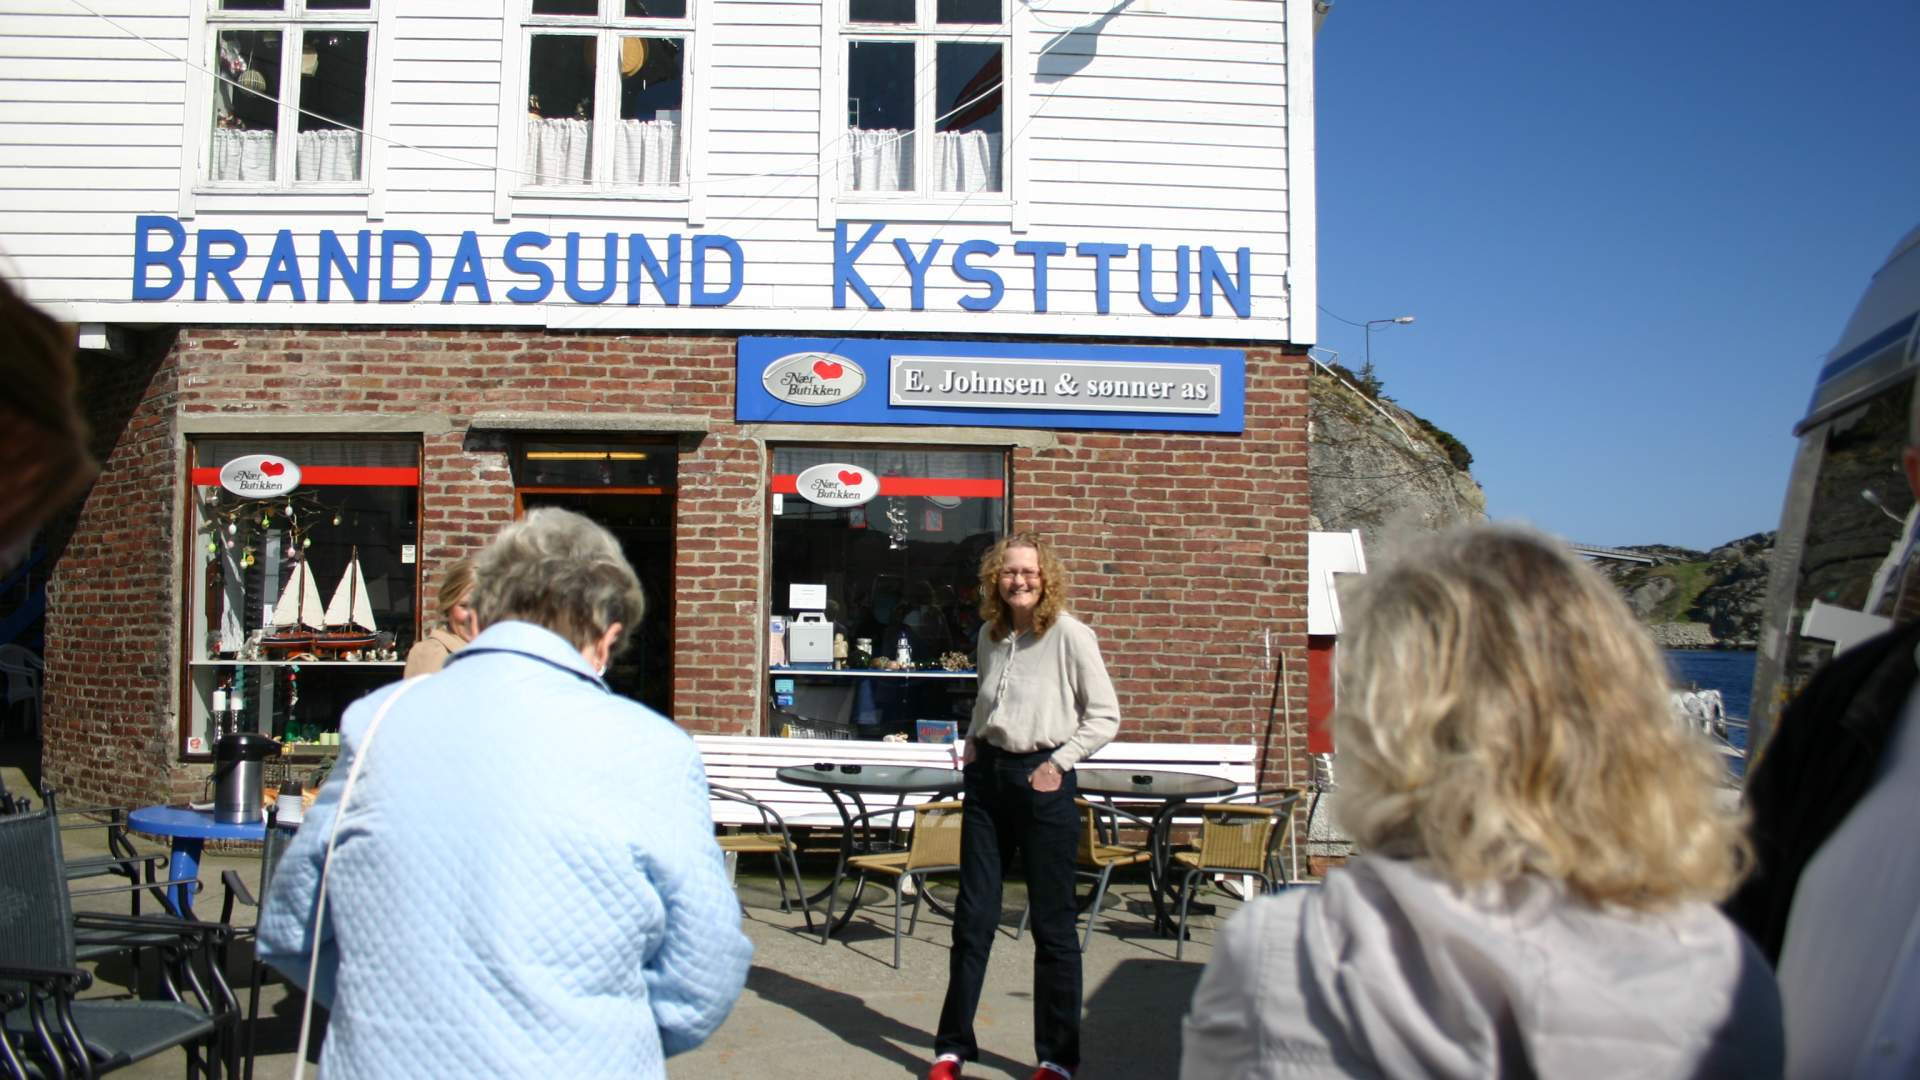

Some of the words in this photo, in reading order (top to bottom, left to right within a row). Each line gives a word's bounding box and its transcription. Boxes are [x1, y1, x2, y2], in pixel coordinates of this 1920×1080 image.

[132, 215, 745, 308] BRANDASUND
[832, 219, 1251, 318] KYSTTUN
[780, 371, 815, 386] Nær
[904, 368, 932, 393] E.
[939, 369, 1047, 395] Johnsen
[1054, 372, 1078, 396] &
[1086, 377, 1175, 400] sønner
[1181, 382, 1209, 400] as
[787, 384, 842, 396] Butikken
[233, 470, 262, 481] Nær
[239, 480, 283, 491] Butikken
[810, 478, 839, 490] Nær
[816, 489, 862, 499] Butikken
